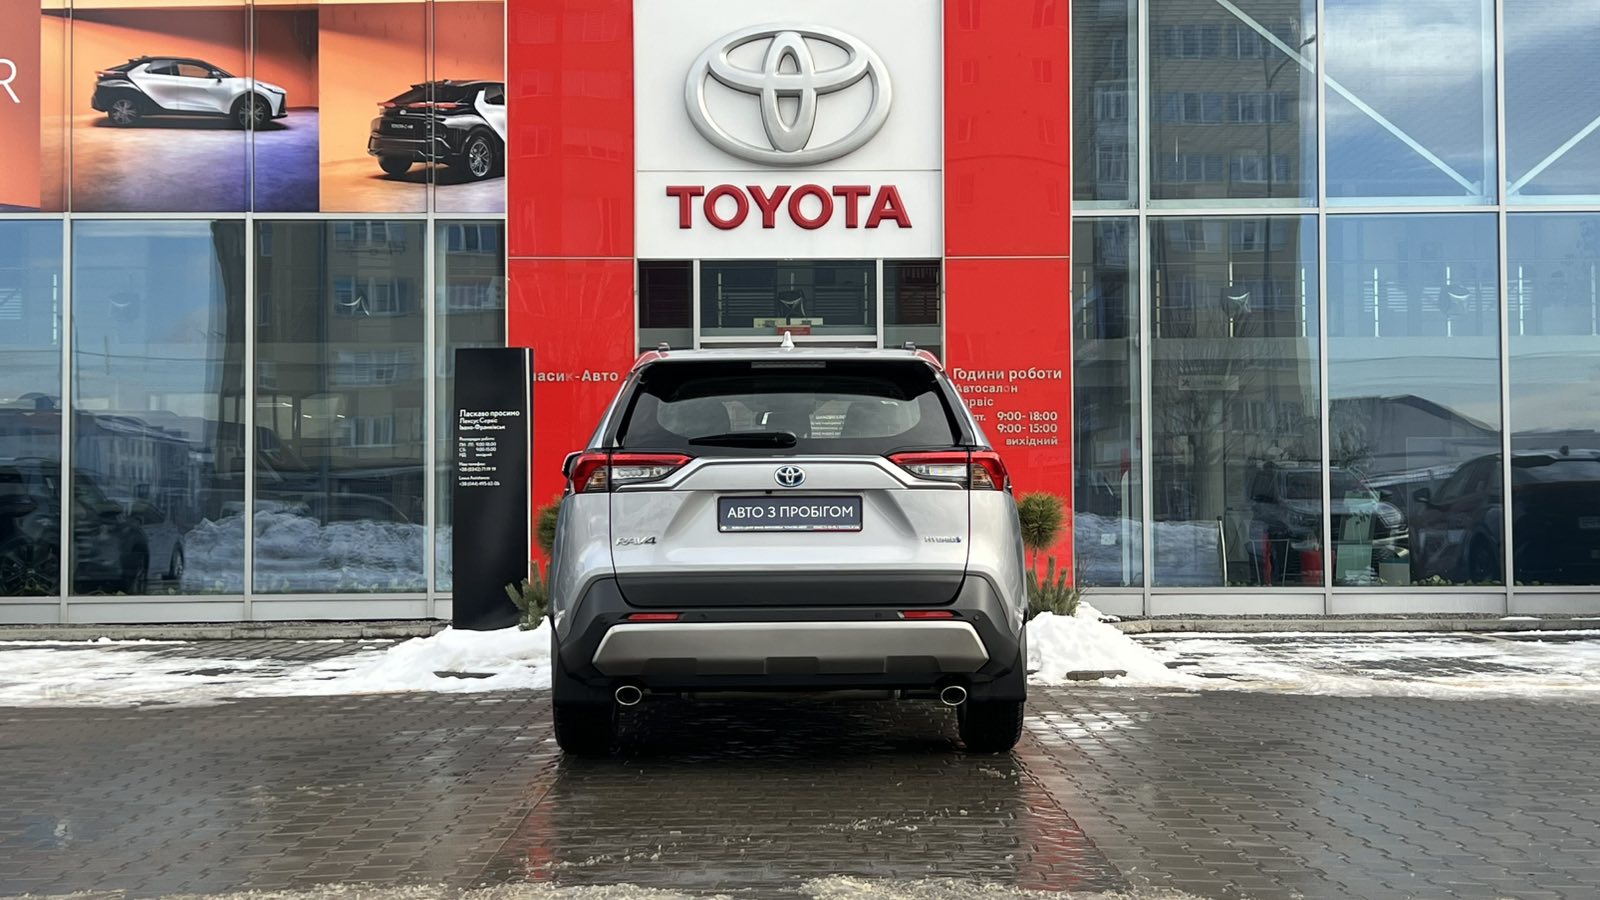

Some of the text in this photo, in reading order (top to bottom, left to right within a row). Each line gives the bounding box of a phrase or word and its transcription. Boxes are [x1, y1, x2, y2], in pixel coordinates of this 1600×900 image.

[666, 184, 912, 230] TOYOTA
[953, 367, 1062, 382] Години роботи
[490, 410, 520, 418] просимо
[1006, 436, 1058, 446] вихідний
[727, 506, 764, 519] АВТО
[780, 506, 853, 518] ПРОБІГОМ
[615, 536, 657, 546] RAV4
